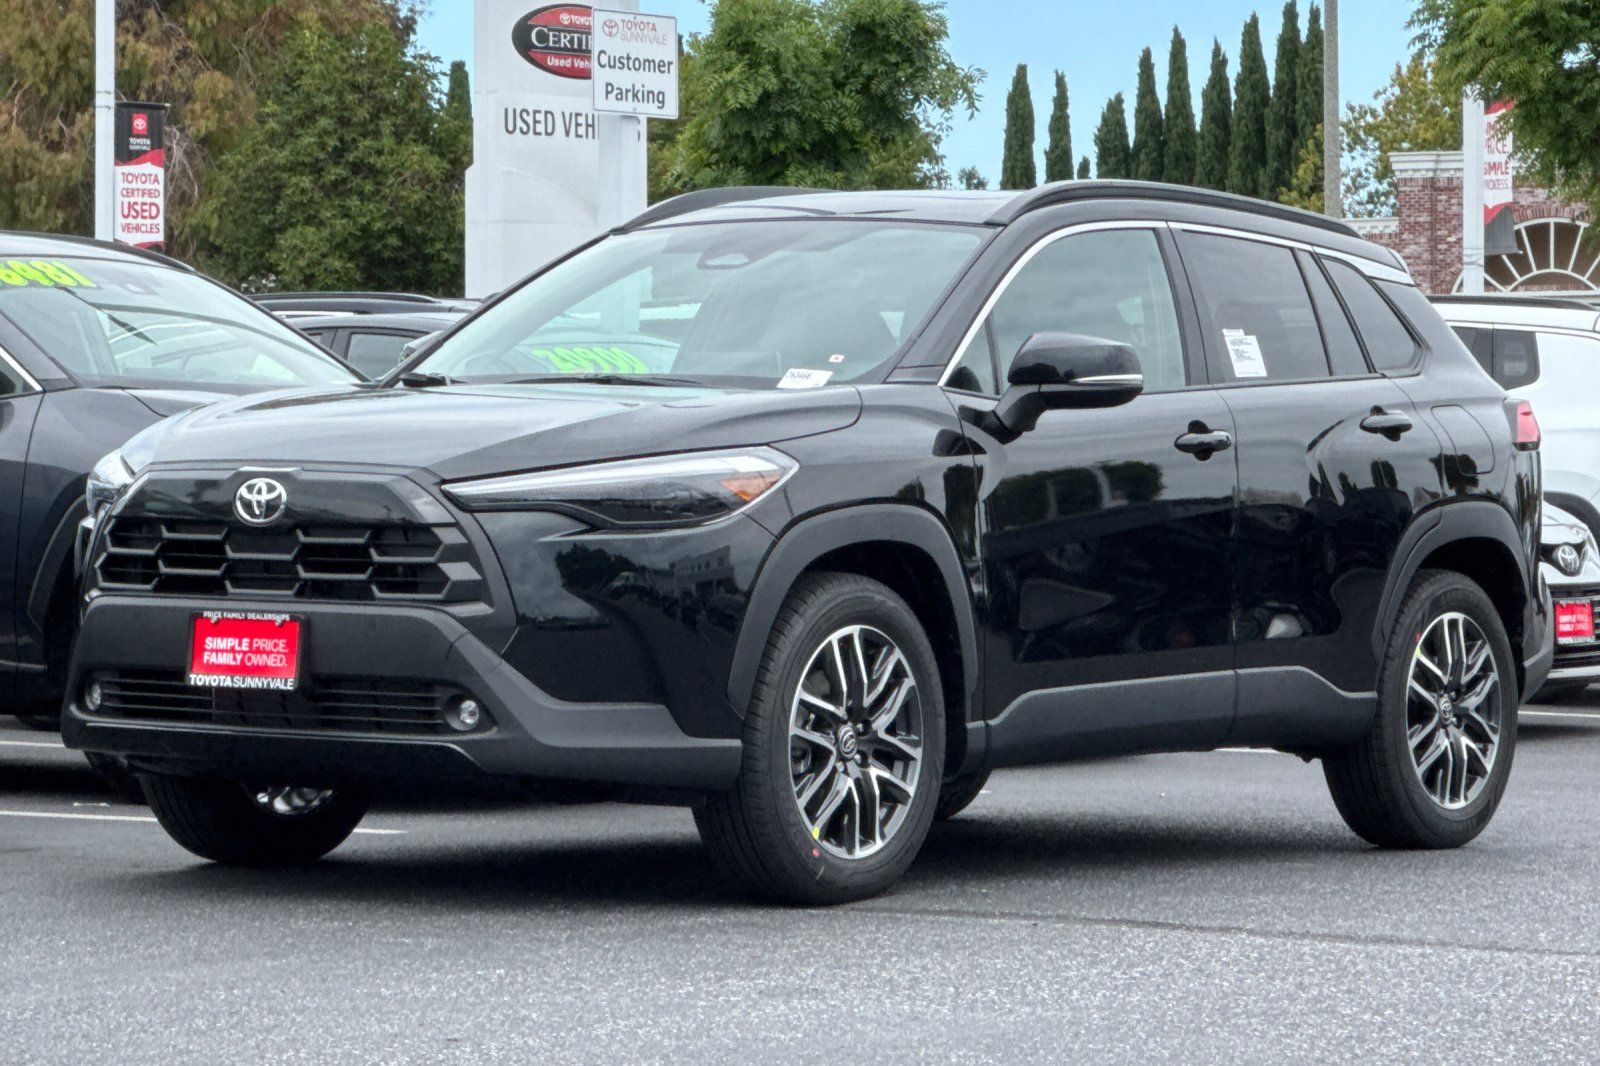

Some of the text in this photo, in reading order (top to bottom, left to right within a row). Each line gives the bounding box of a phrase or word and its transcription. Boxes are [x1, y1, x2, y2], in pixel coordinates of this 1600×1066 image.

[620, 19, 657, 33] TOYOTA
[530, 26, 592, 50] CERTI
[619, 32, 668, 46] SUNNYVALE
[547, 55, 592, 69] Used Veh
[597, 50, 674, 75] Customer
[605, 82, 665, 109] Parking
[504, 107, 556, 137] USED
[121, 172, 160, 185] TOYOTA
[121, 188, 160, 199] CERTIFIED
[121, 201, 160, 220] USED
[121, 222, 160, 234] VEHICLES
[203, 611, 290, 621] PRICE FAMILY DEALERSHIPS
[205, 637, 250, 651] SIMPLE
[203, 652, 243, 666] FAMILY
[189, 674, 295, 690] TOYOTA SUNNYVALE
